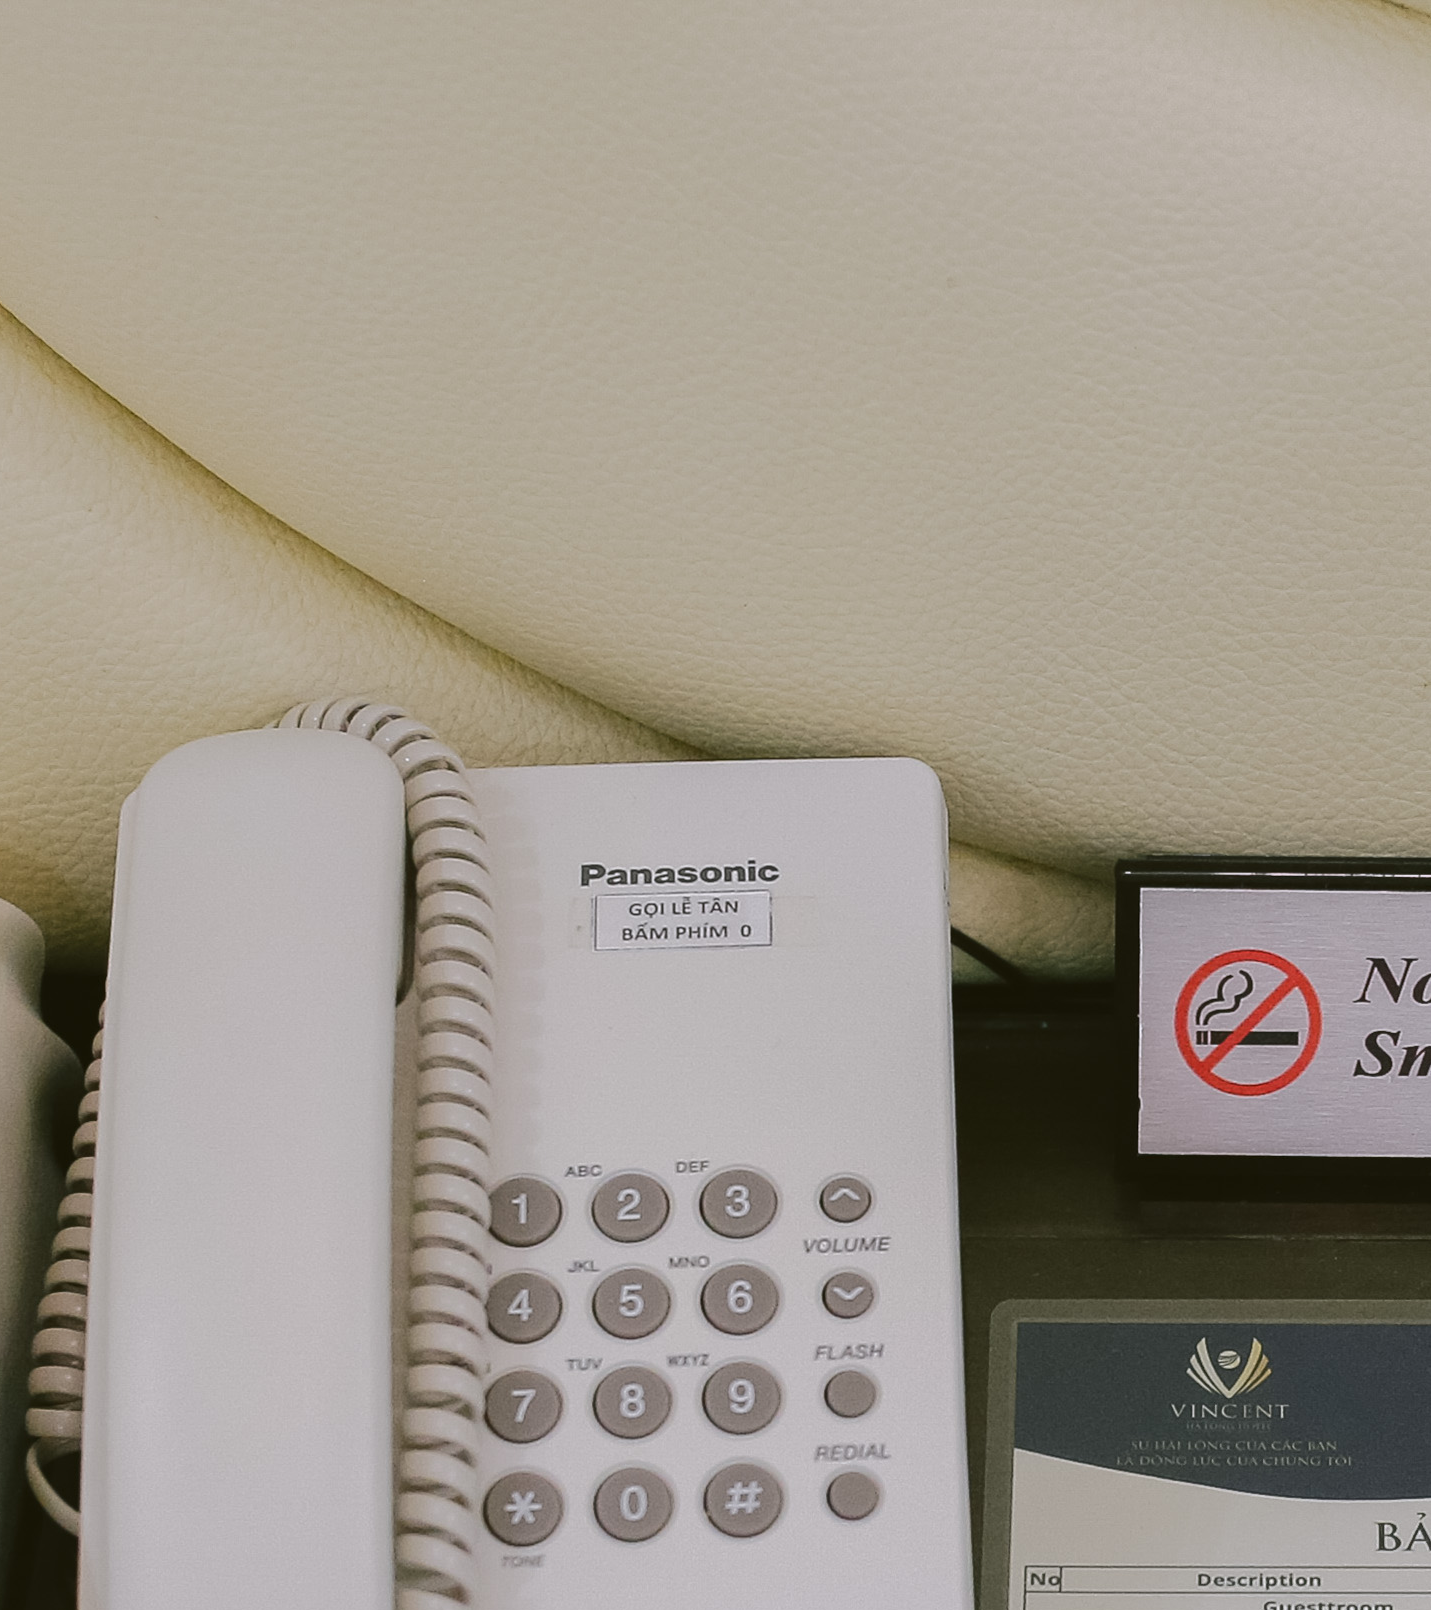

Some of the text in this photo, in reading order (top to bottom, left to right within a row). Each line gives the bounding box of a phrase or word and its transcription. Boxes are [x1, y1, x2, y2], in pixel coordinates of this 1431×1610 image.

[580, 860, 780, 887] Panasonic
[628, 902, 665, 919] GỌI
[698, 898, 739, 914] TÂN
[622, 922, 752, 941] BẤM PHÍM 0
[565, 1160, 709, 1178] ABC DEF
[512, 1185, 750, 1224] 1 2 3
[803, 1237, 891, 1254] VOLUME
[568, 1256, 710, 1273] JKL MNO
[507, 1280, 753, 1321] 4 5 6
[566, 1353, 709, 1371] TUV WXYZ
[815, 1344, 884, 1361] FLASH
[511, 1380, 755, 1422] 7 8 9
[1171, 1404, 1285, 1419] VINCENT
[815, 1444, 891, 1461] REDIAL
[621, 1485, 647, 1521] 0
[1030, 1574, 1060, 1587] No
[1197, 1572, 1322, 1591] Description
